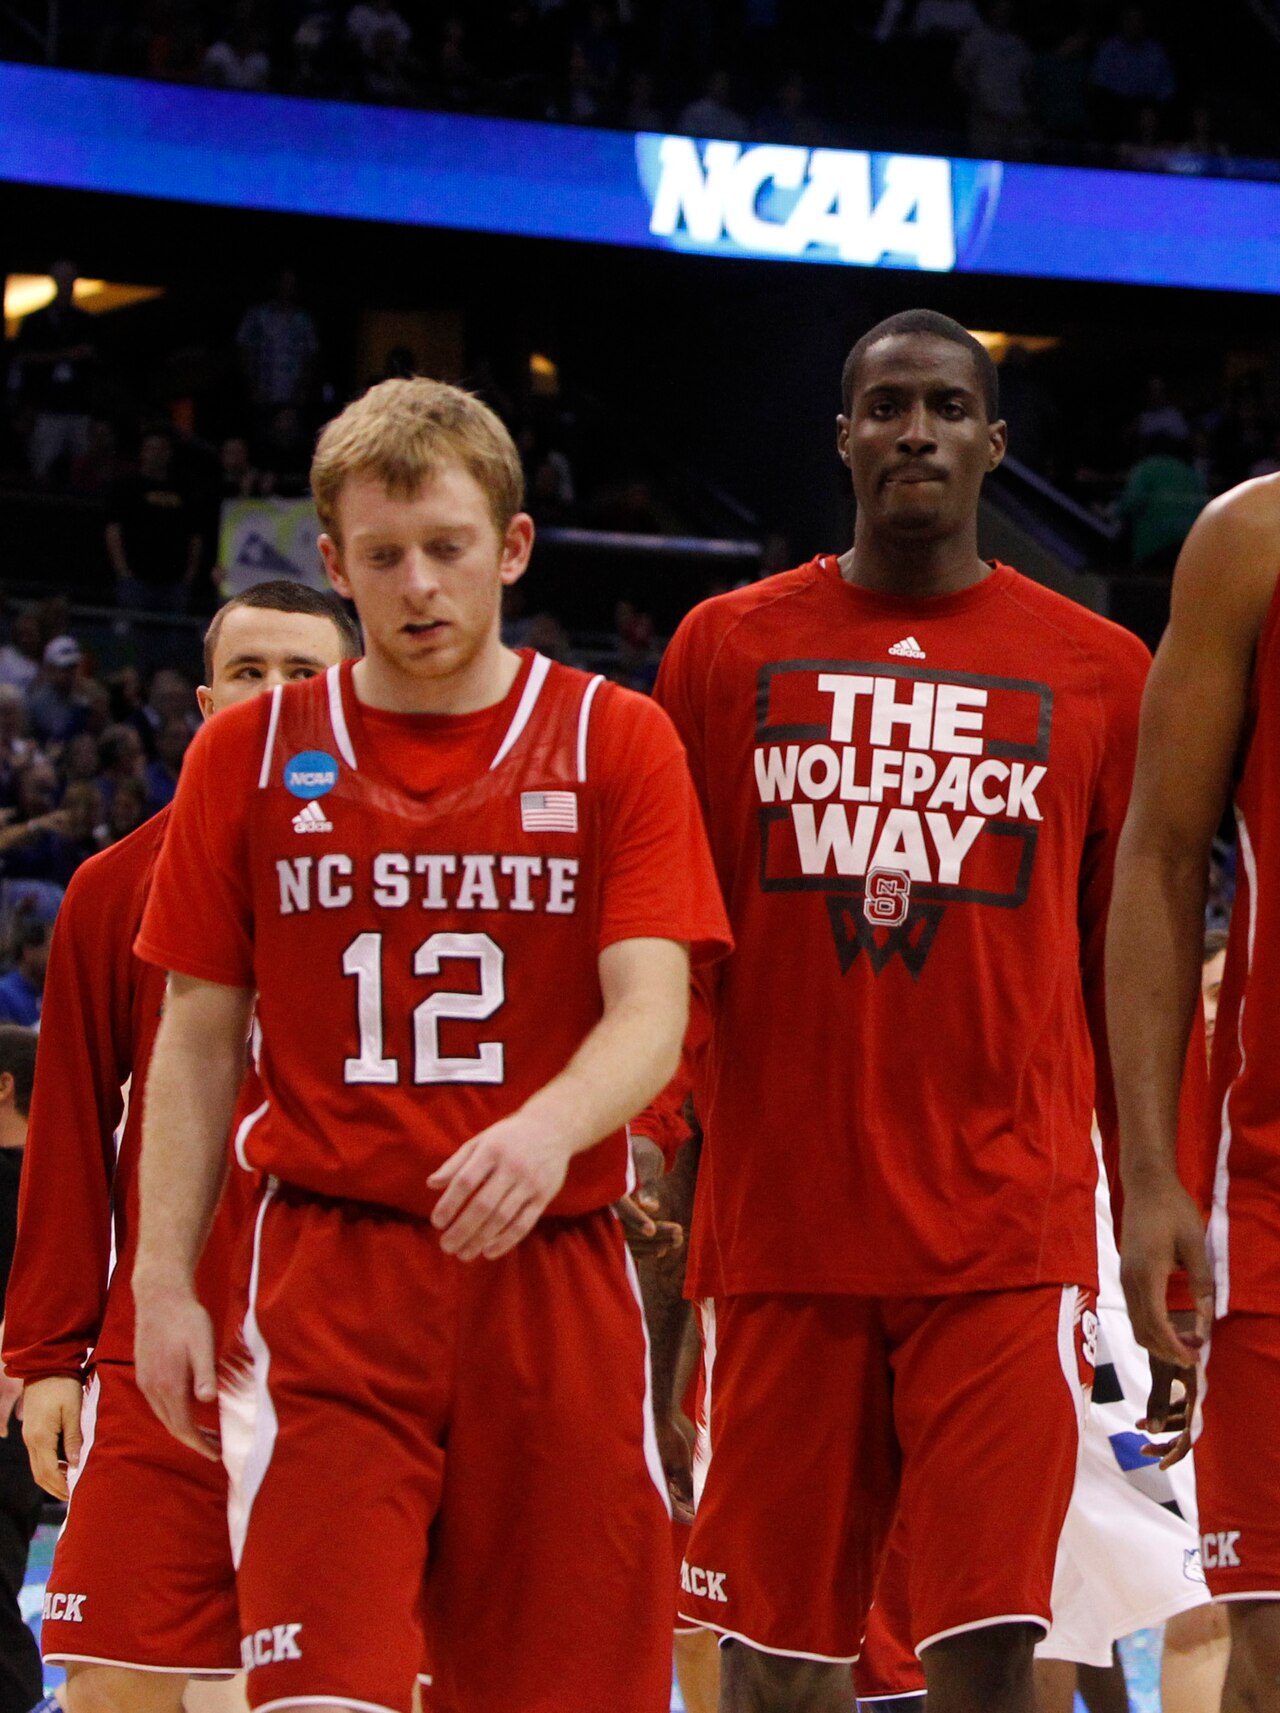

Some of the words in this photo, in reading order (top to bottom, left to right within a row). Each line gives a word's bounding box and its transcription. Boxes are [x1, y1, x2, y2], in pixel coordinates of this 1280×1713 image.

[650, 136, 955, 270] NCAA
[888, 647, 926, 660] adidas
[816, 672, 989, 757] THE
[290, 771, 336, 787] NCAA
[754, 743, 1048, 821] WOLFPACK
[275, 853, 353, 914] NC
[373, 852, 580, 914] STATE
[791, 803, 986, 885] WAY
[341, 931, 506, 1085] 12
